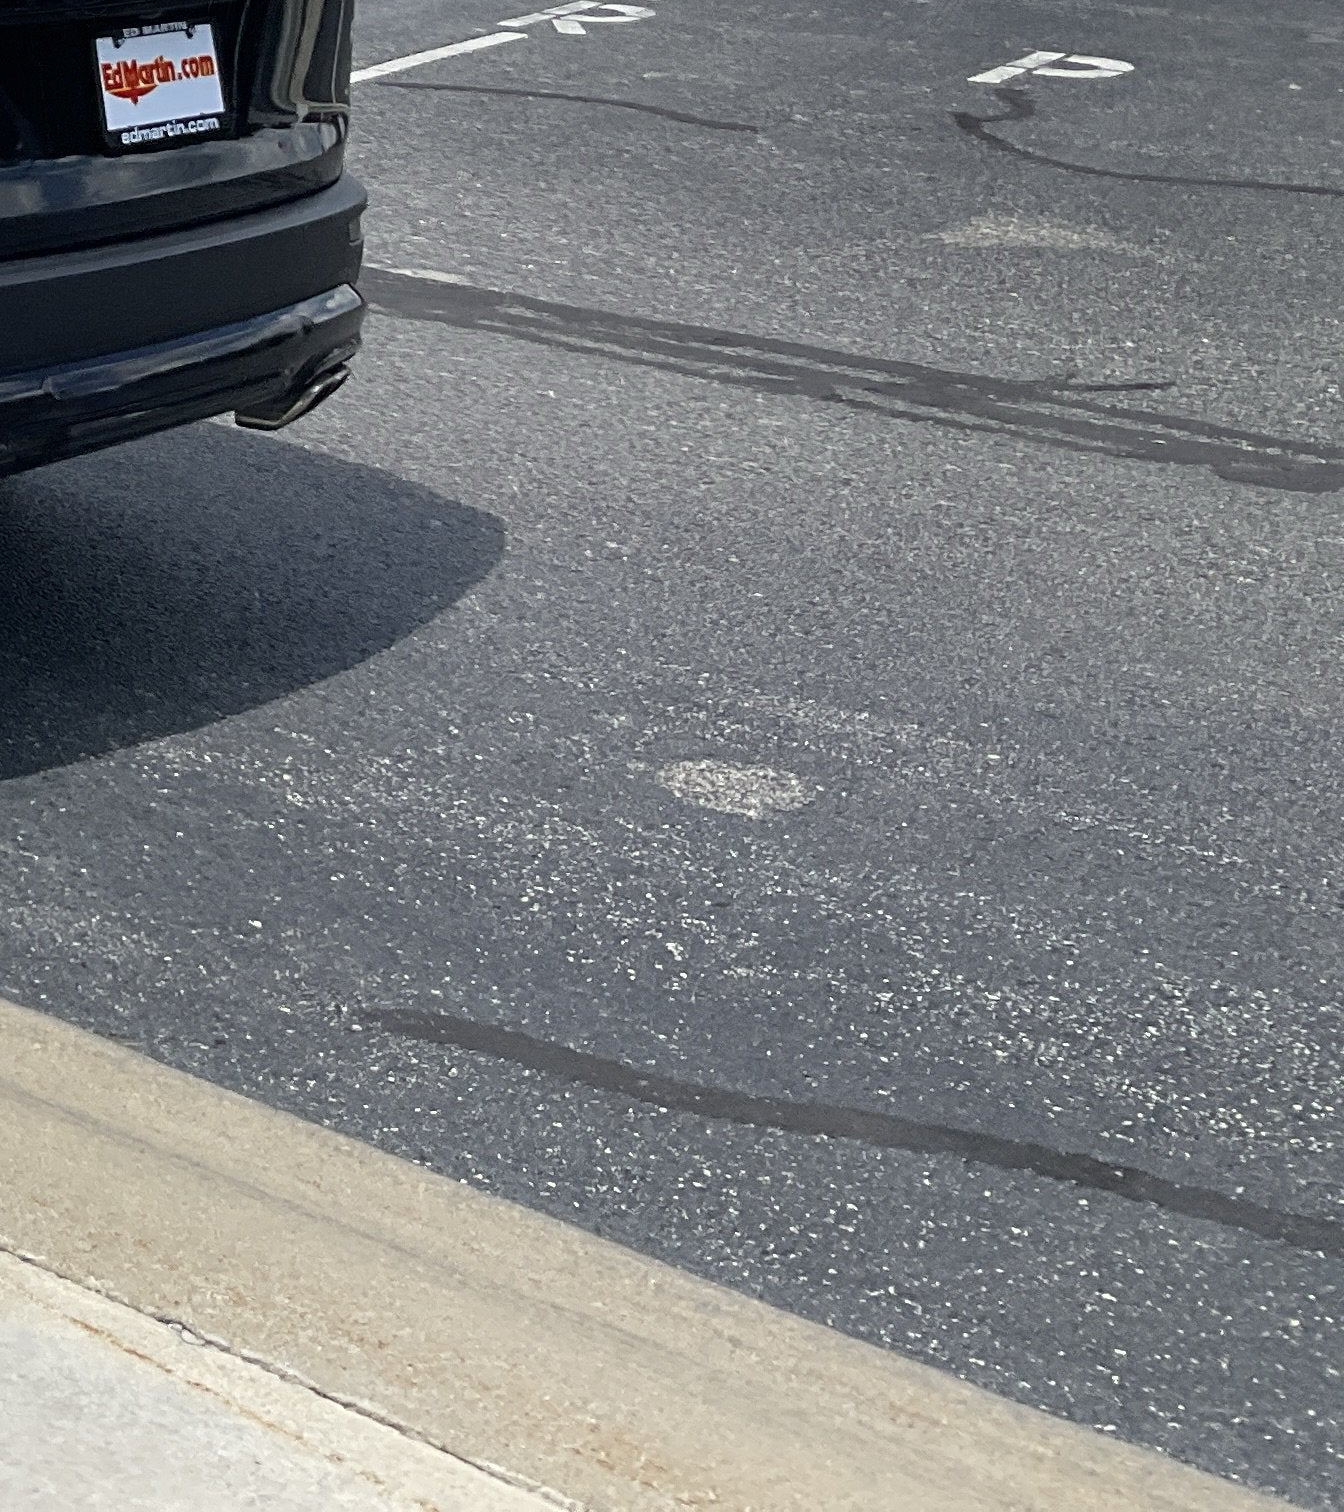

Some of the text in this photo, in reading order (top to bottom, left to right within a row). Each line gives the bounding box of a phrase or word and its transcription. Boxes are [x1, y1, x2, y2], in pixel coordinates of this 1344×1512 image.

[122, 20, 188, 39] ED MARTIN
[101, 54, 216, 91] EdMartin.com
[120, 116, 221, 146] edmartin.com
